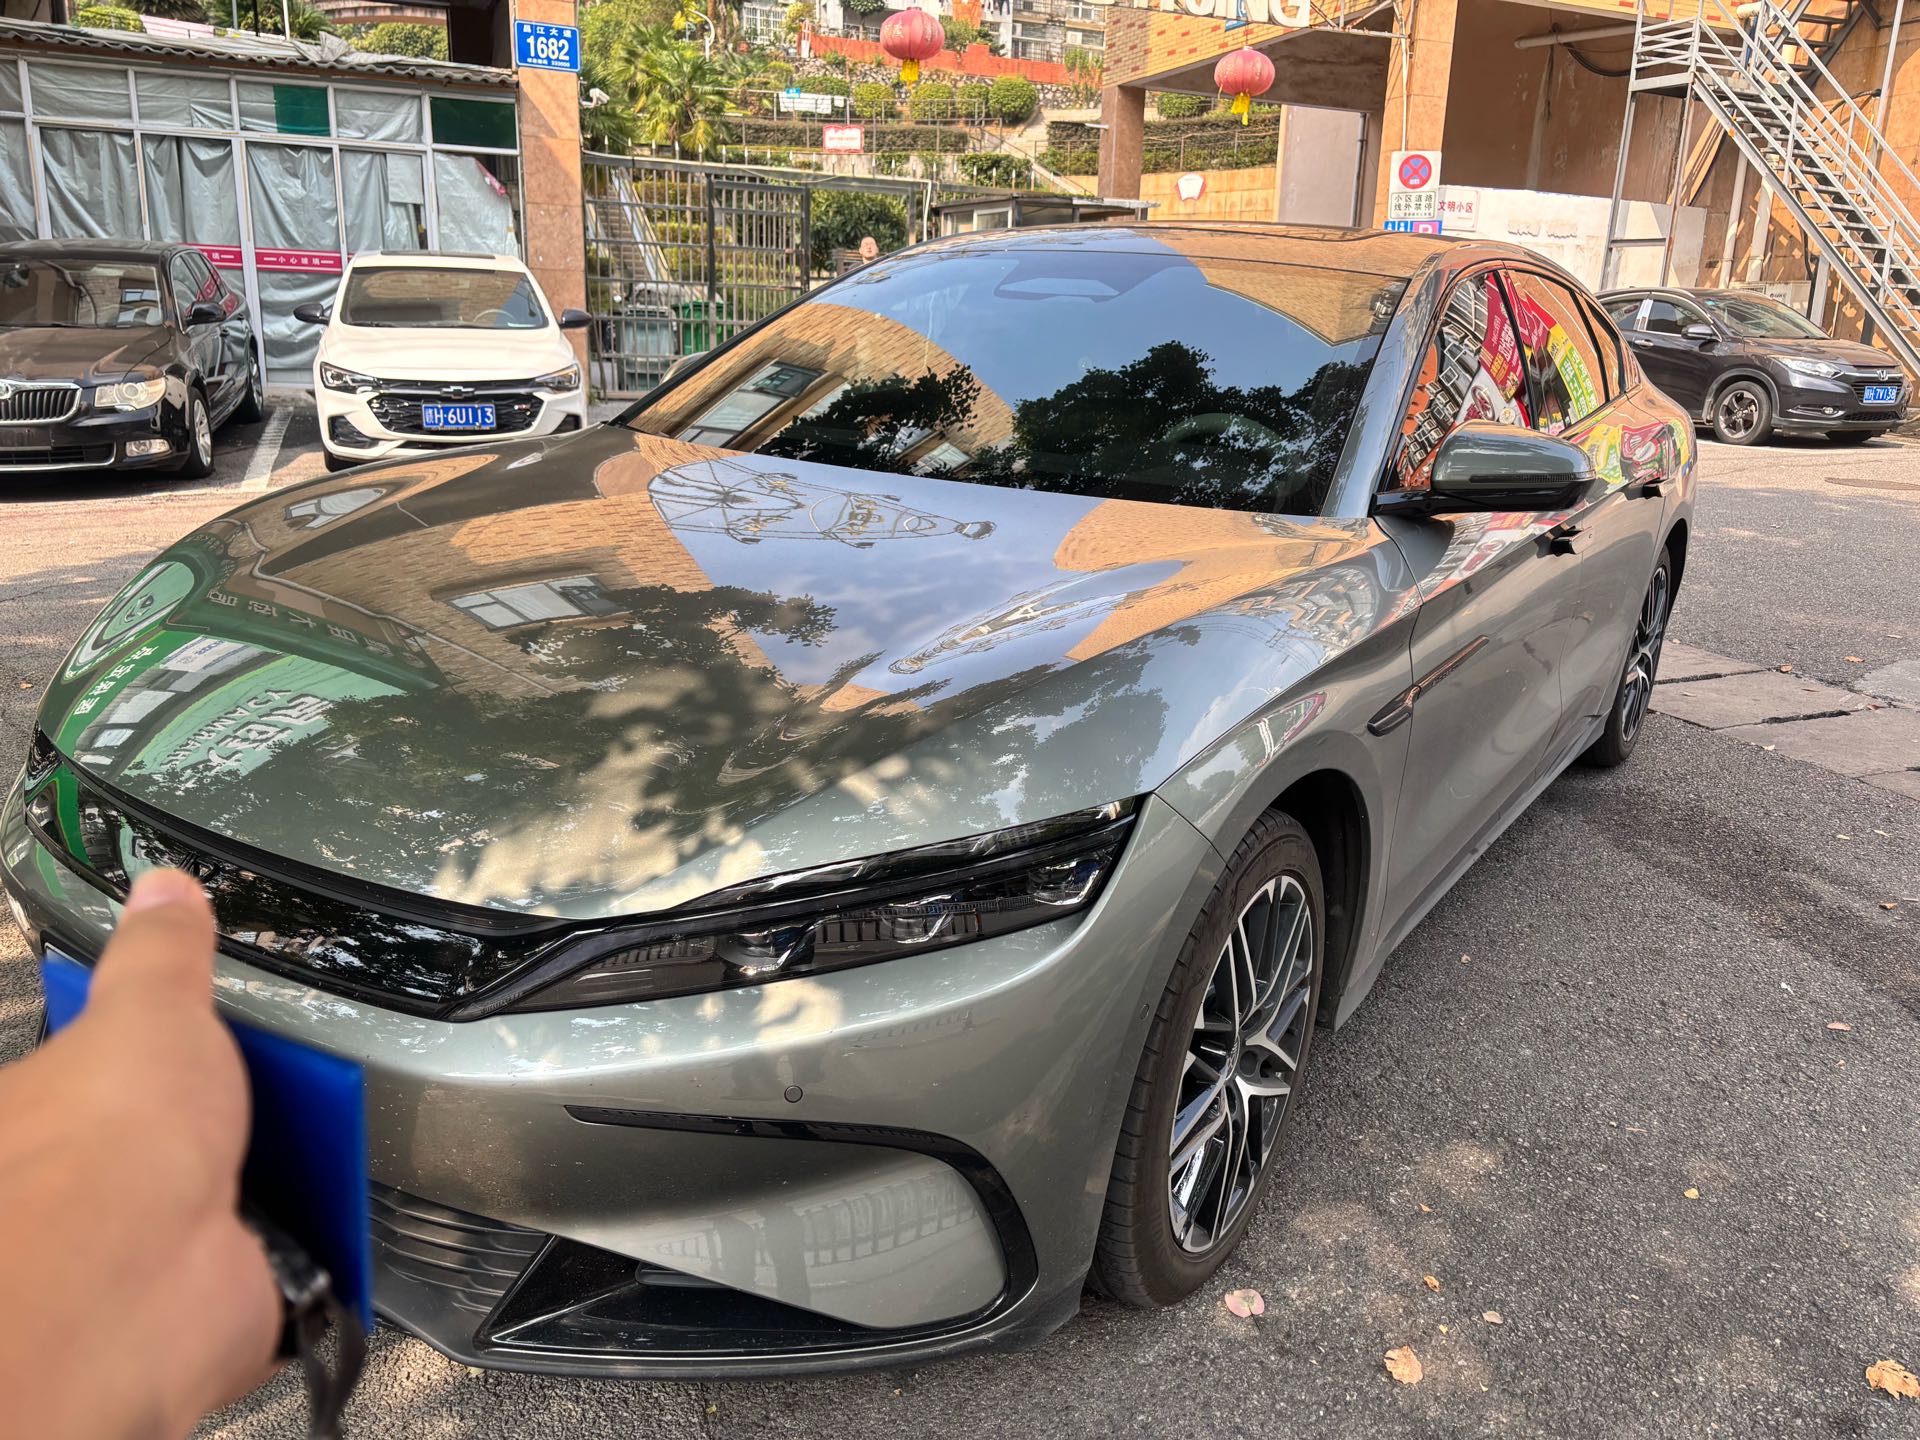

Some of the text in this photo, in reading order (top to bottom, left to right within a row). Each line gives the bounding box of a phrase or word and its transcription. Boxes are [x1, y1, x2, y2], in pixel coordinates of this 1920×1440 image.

[526, 35, 570, 60] 1682
[1438, 200, 1473, 213] 文明小区
